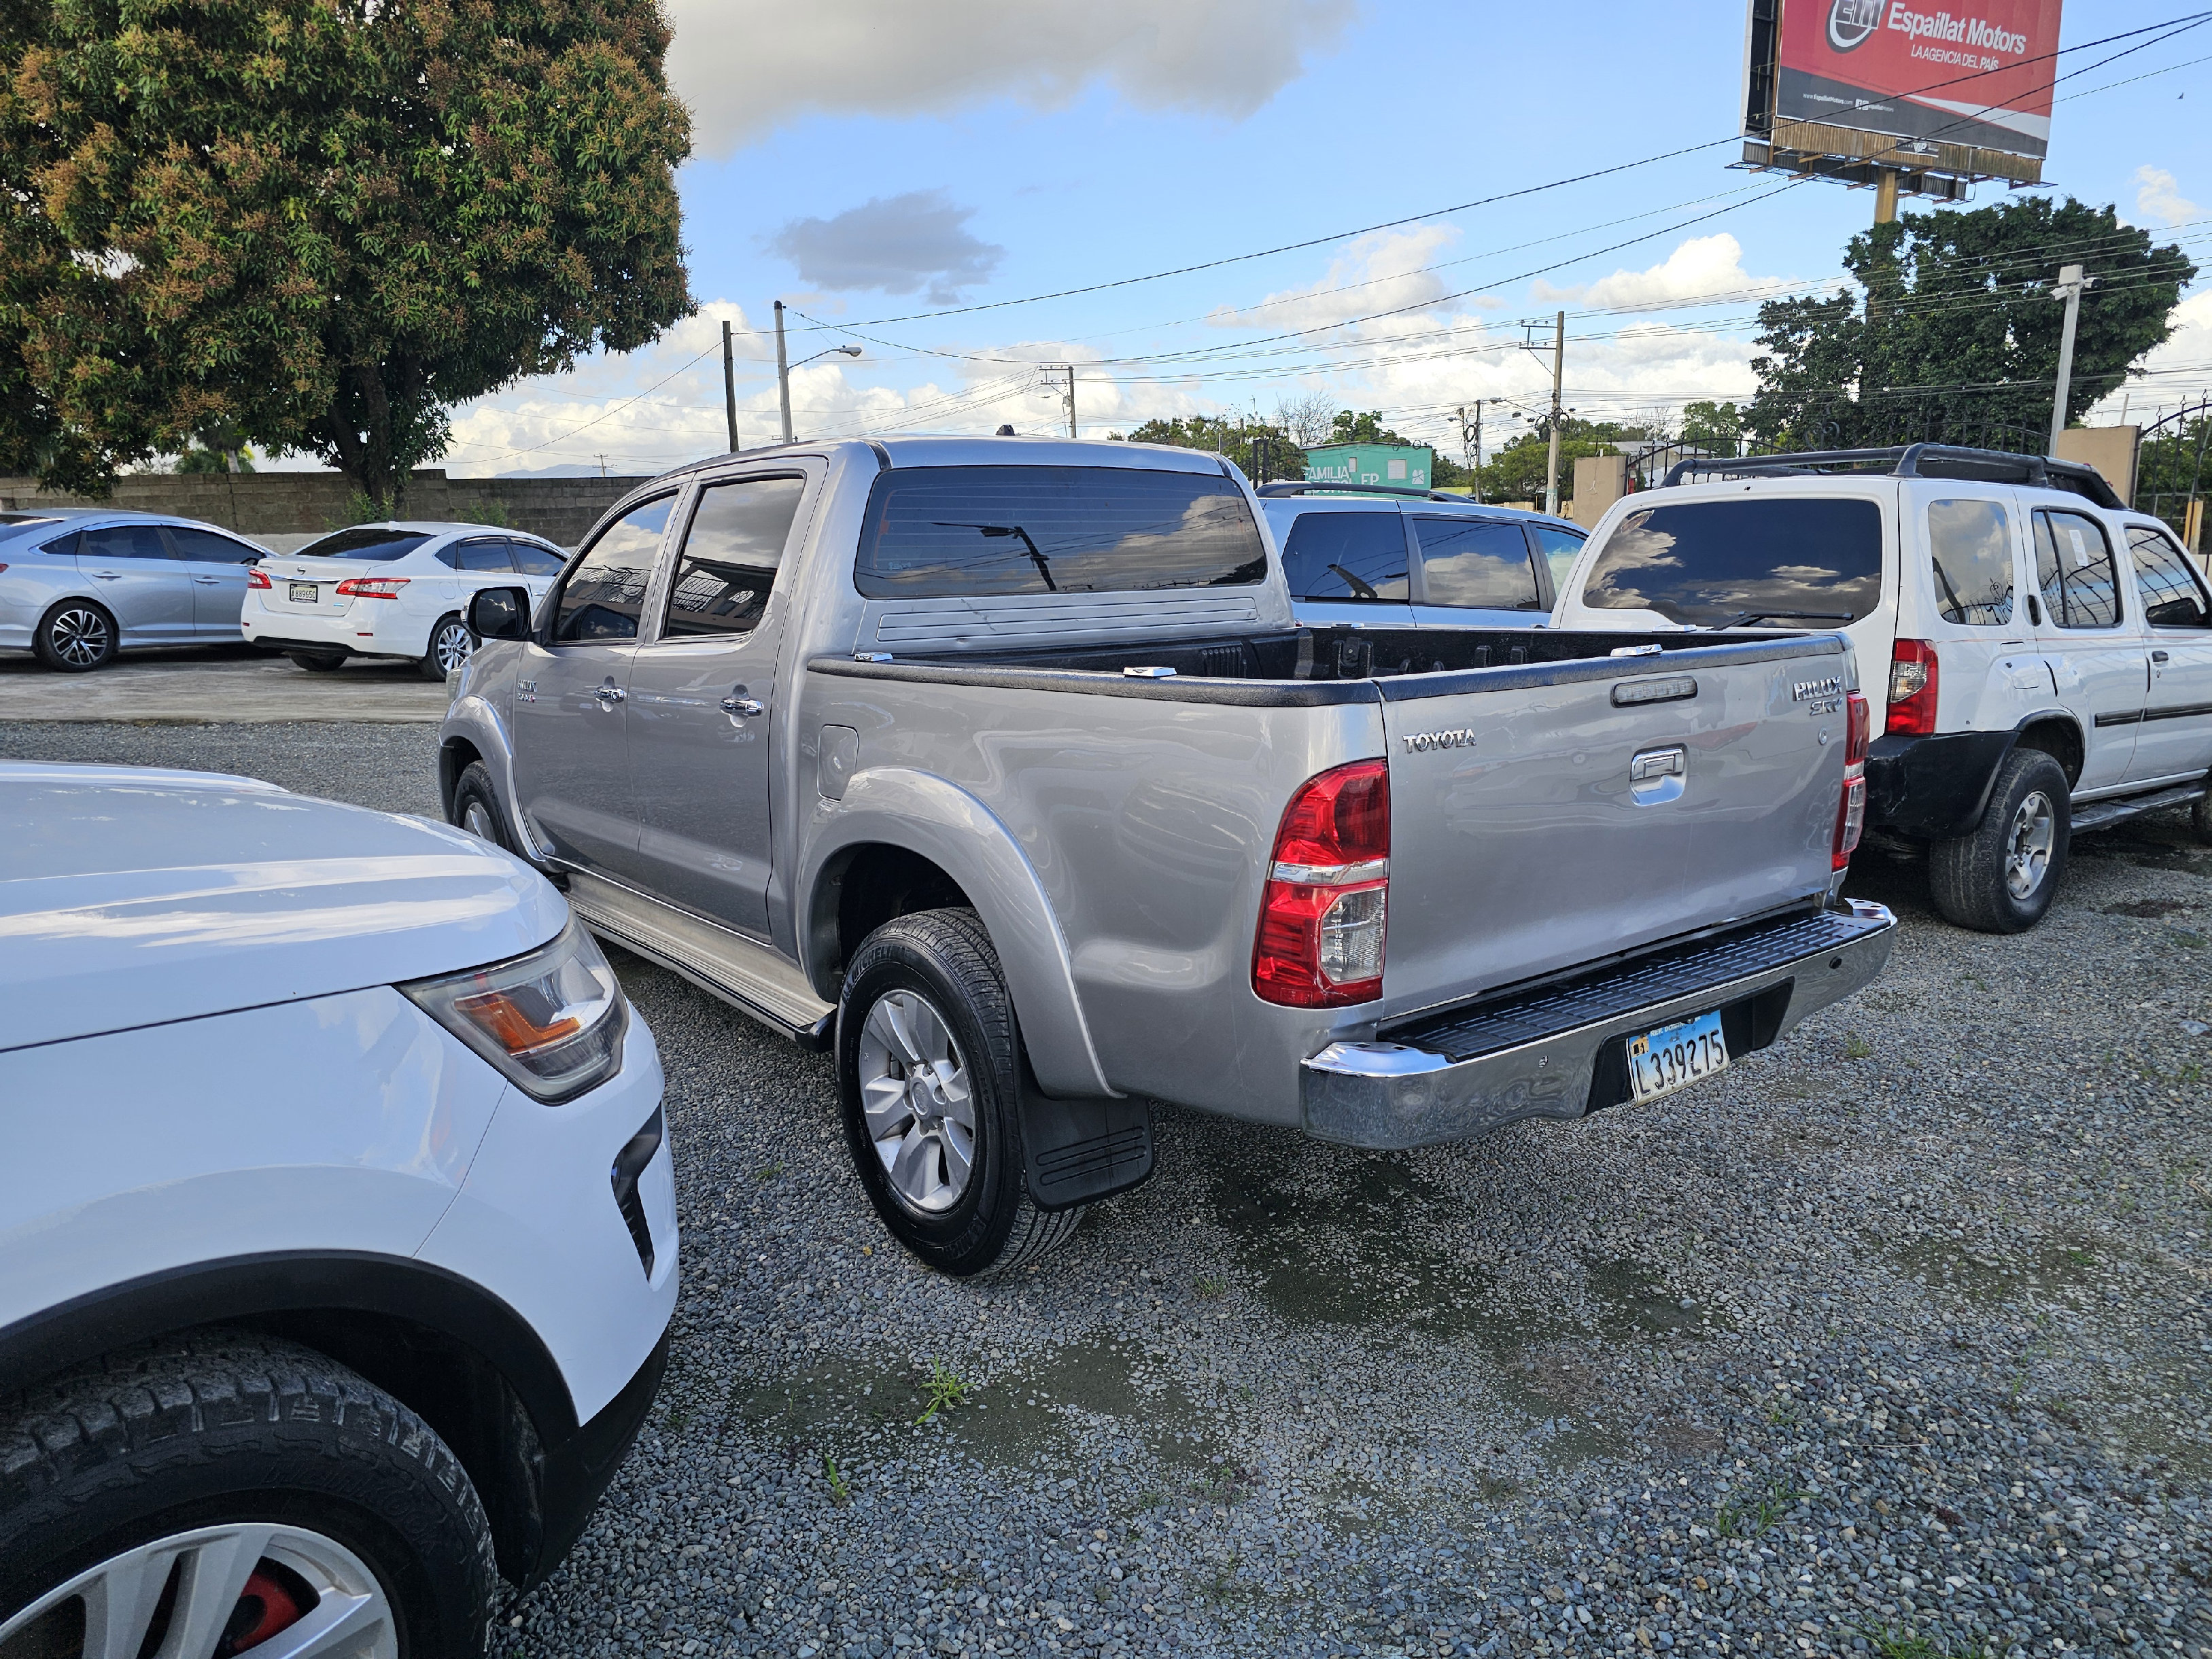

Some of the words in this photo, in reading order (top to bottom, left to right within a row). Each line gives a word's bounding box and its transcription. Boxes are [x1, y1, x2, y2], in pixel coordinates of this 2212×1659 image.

[1888, 1, 1966, 43] Espaillat
[1966, 18, 2026, 54] Motors
[1911, 44, 1923, 58] LA
[1922, 46, 1962, 65] AGENCIA
[1962, 53, 1979, 69] DEL
[1980, 56, 1999, 71] PAÍS
[1793, 676, 1843, 701] HILUX
[1810, 697, 1843, 716] SRV
[1402, 729, 1477, 754] TOYOTA
[1635, 1028, 1724, 1096] L339275
